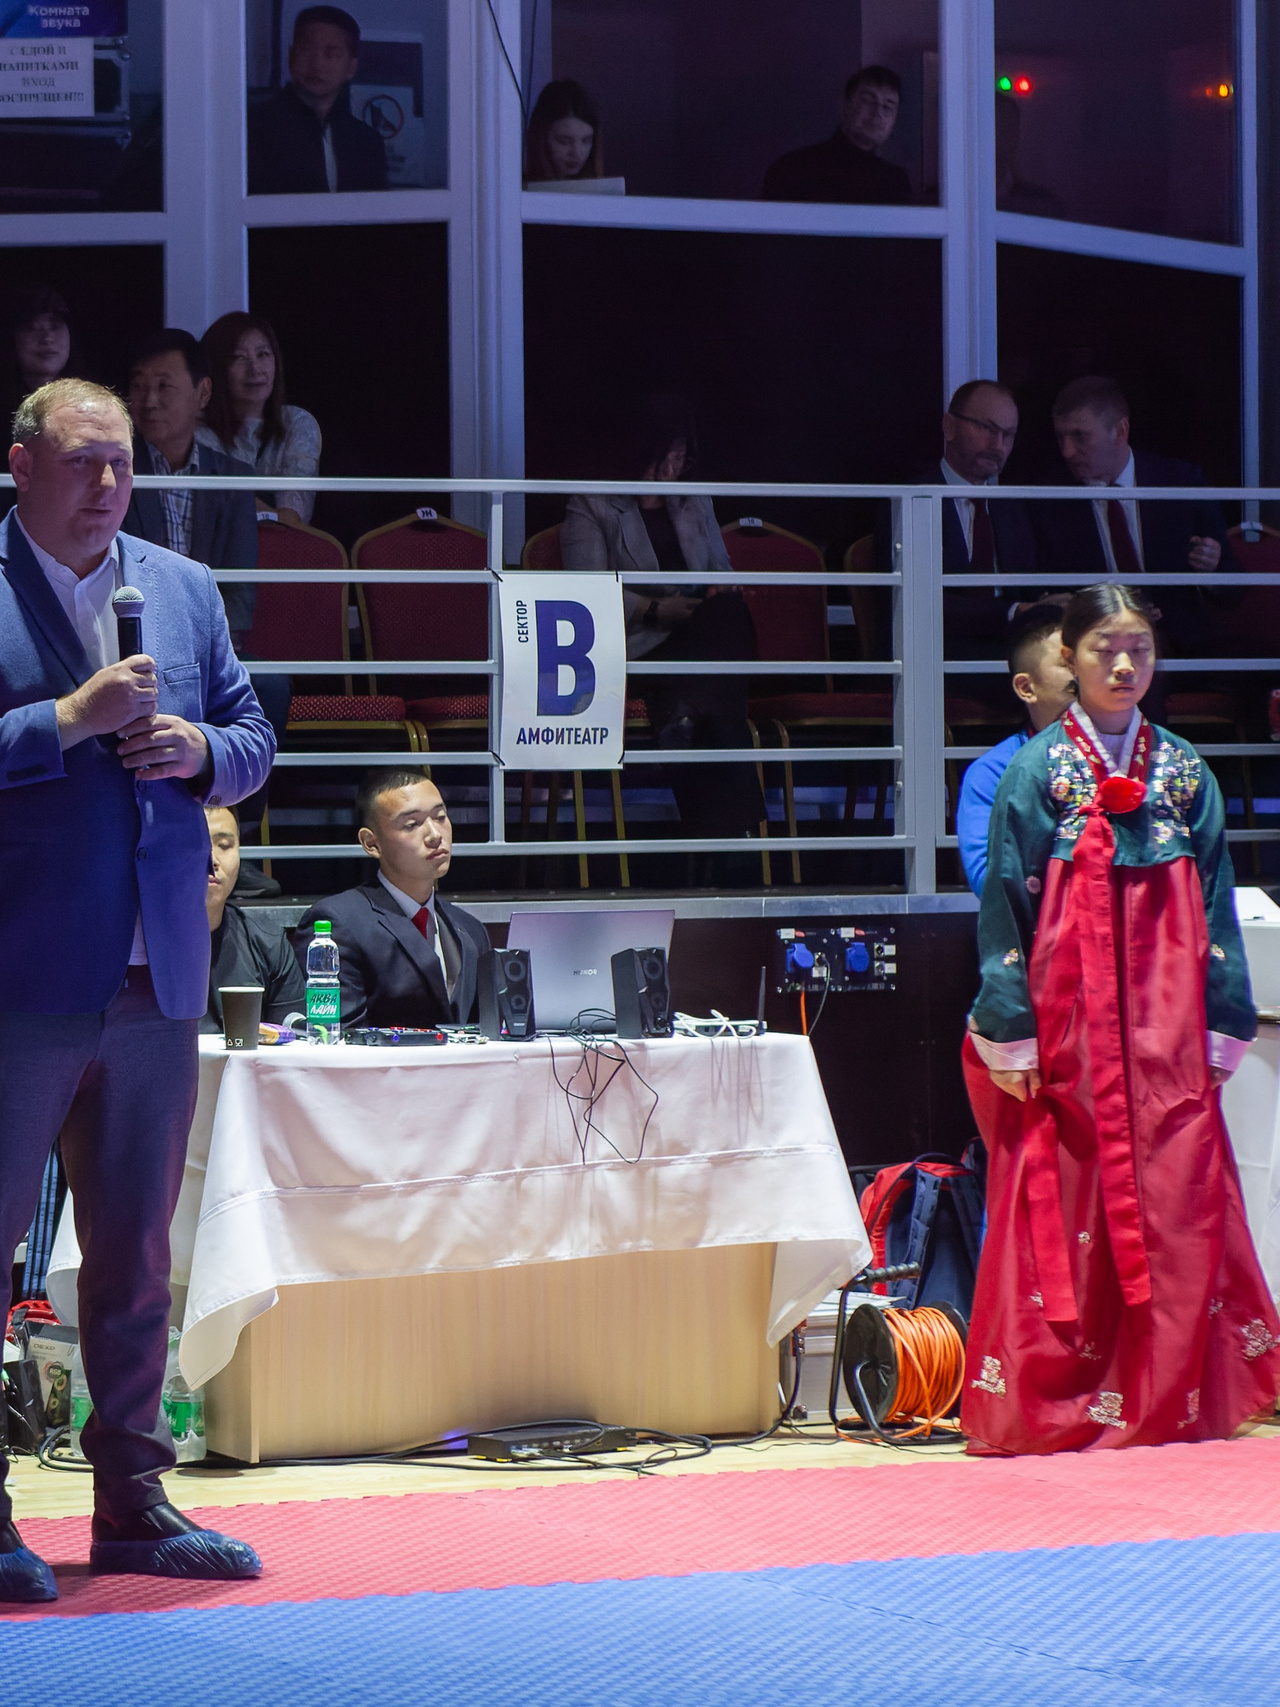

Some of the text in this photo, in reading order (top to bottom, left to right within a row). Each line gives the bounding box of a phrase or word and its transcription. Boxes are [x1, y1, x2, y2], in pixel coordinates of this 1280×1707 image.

[28, 6, 89, 15] Комната
[42, 19, 80, 29] звука
[22, 78, 55, 87] ВХОД
[516, 600, 528, 643] СЕКТОР
[516, 727, 609, 745] АМФИТЕАТР
[310, 993, 337, 1003] АКВА
[310, 1003, 337, 1015] ЛАЙН
